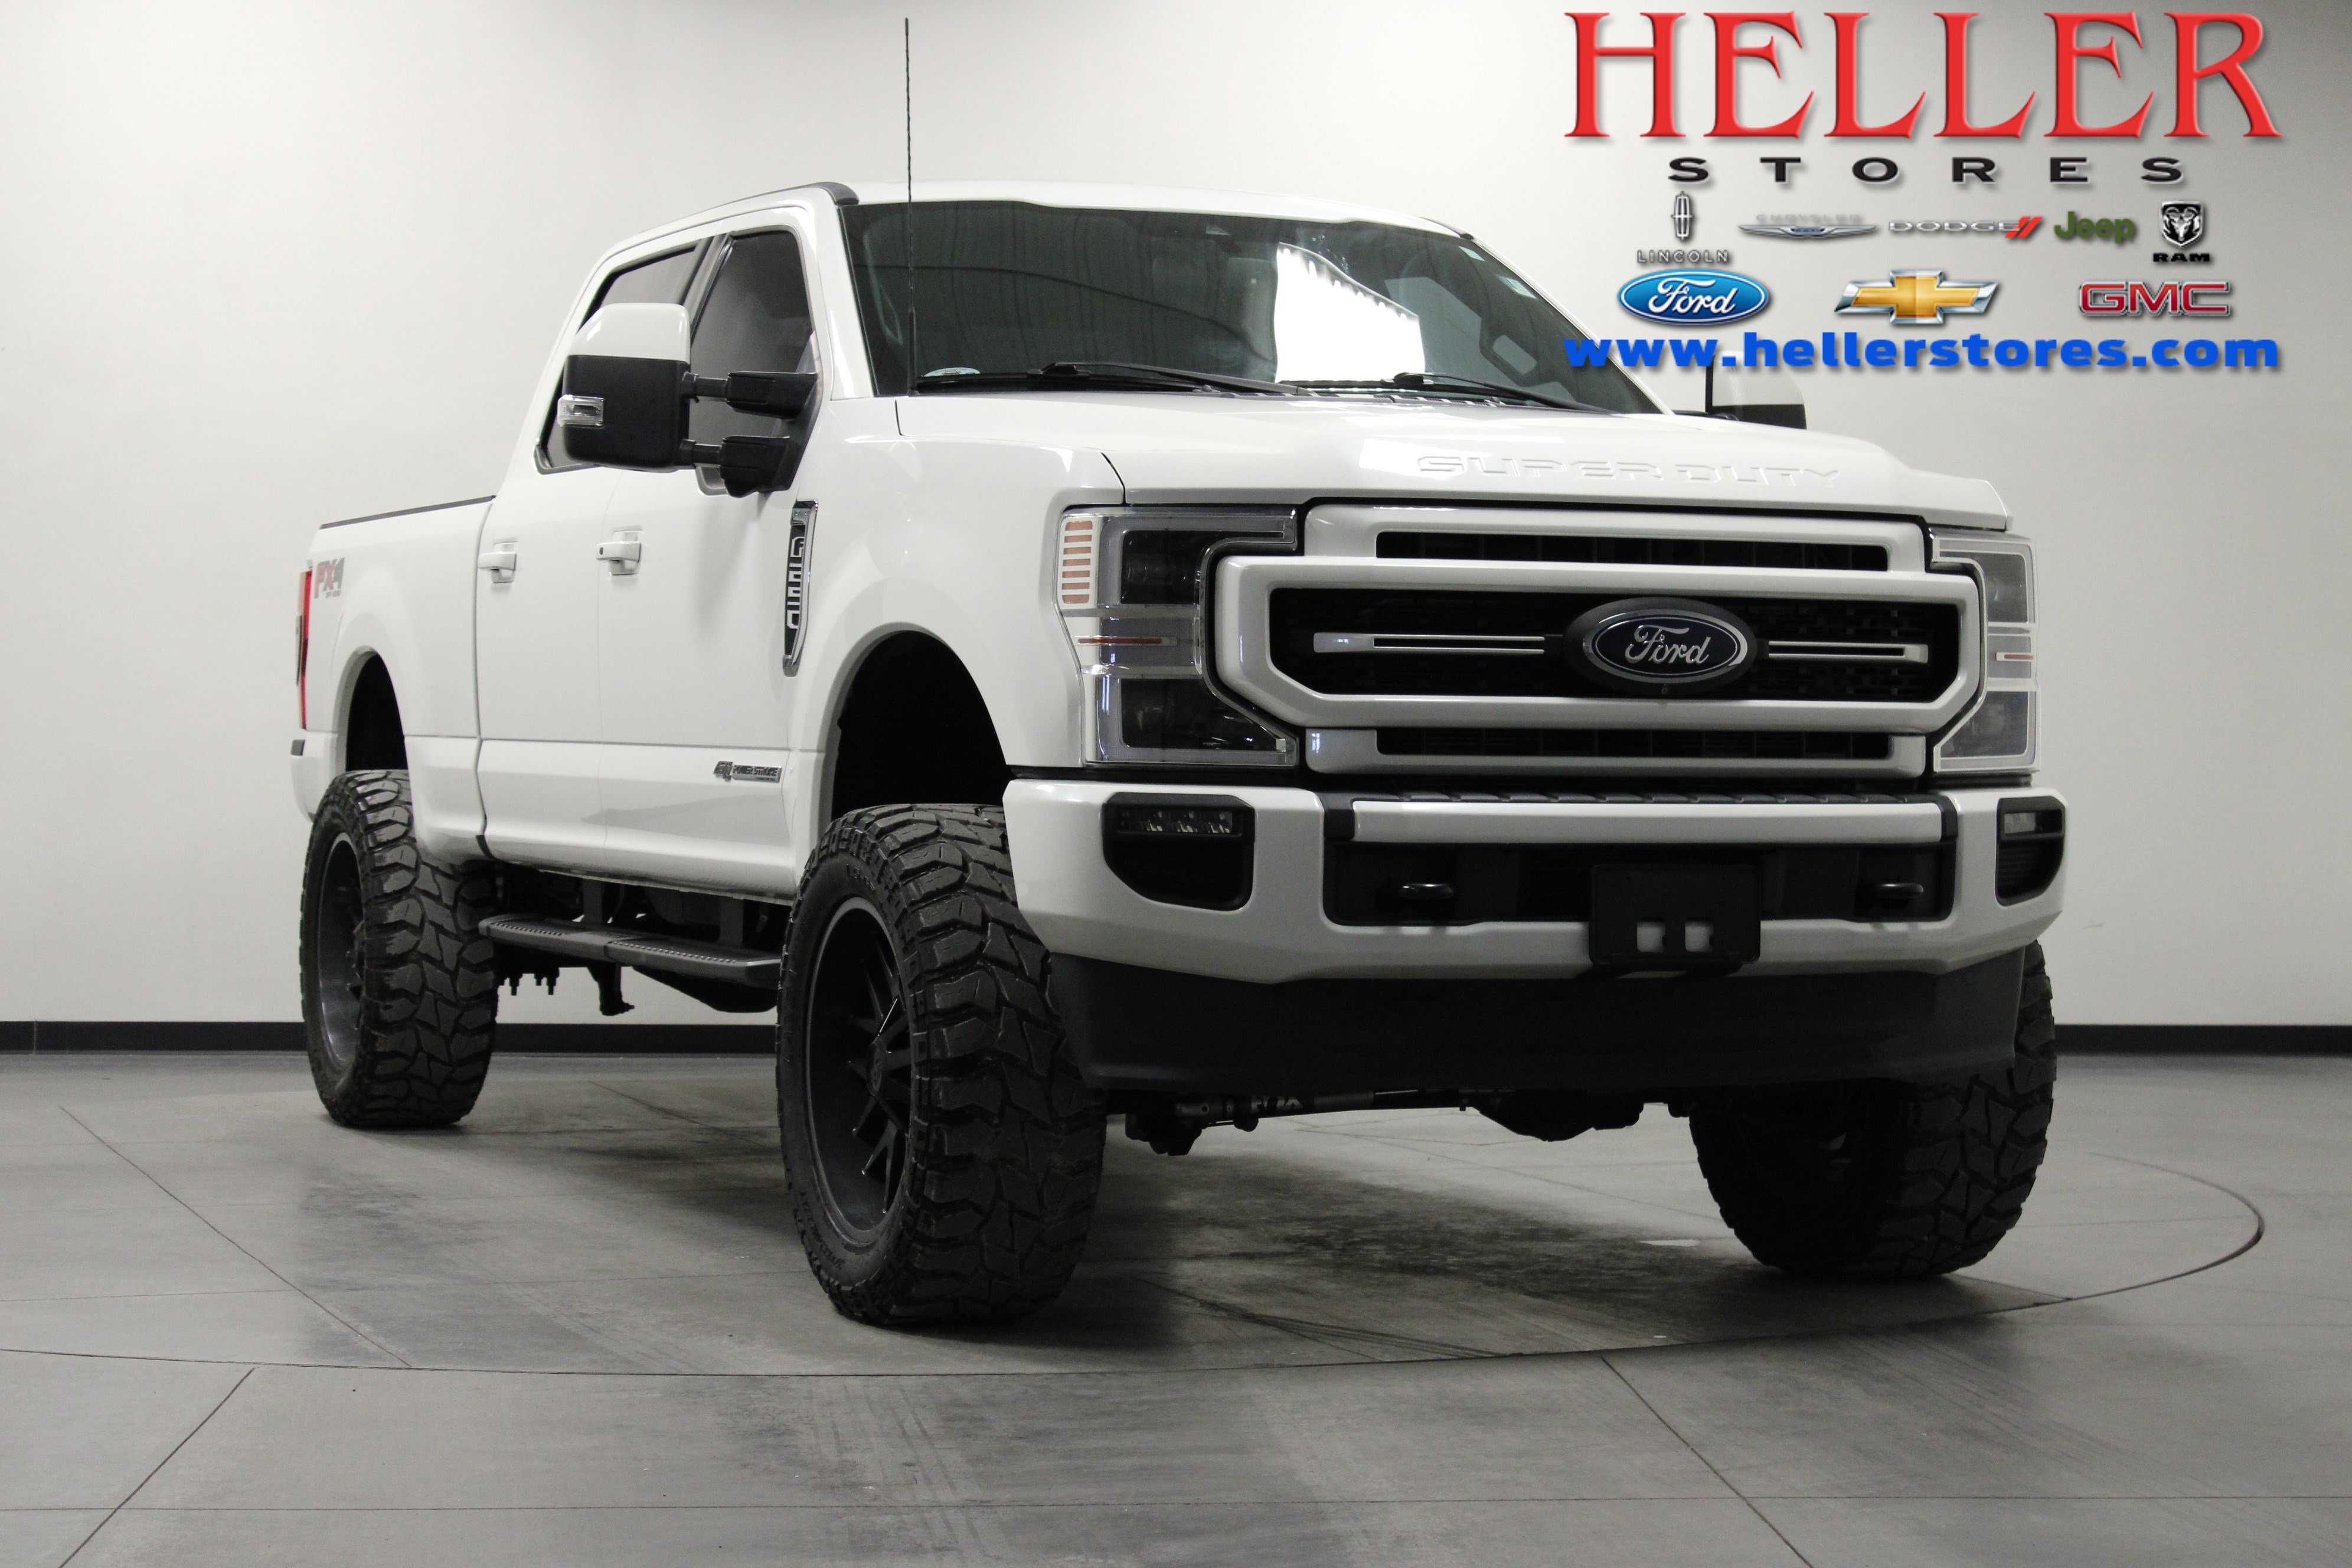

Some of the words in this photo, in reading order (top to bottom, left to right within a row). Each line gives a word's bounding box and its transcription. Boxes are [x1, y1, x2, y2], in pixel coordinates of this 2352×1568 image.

[1416, 455, 1664, 481] SUPER
[1675, 463, 1841, 488] DUTY
[1625, 624, 1711, 665] Ford
